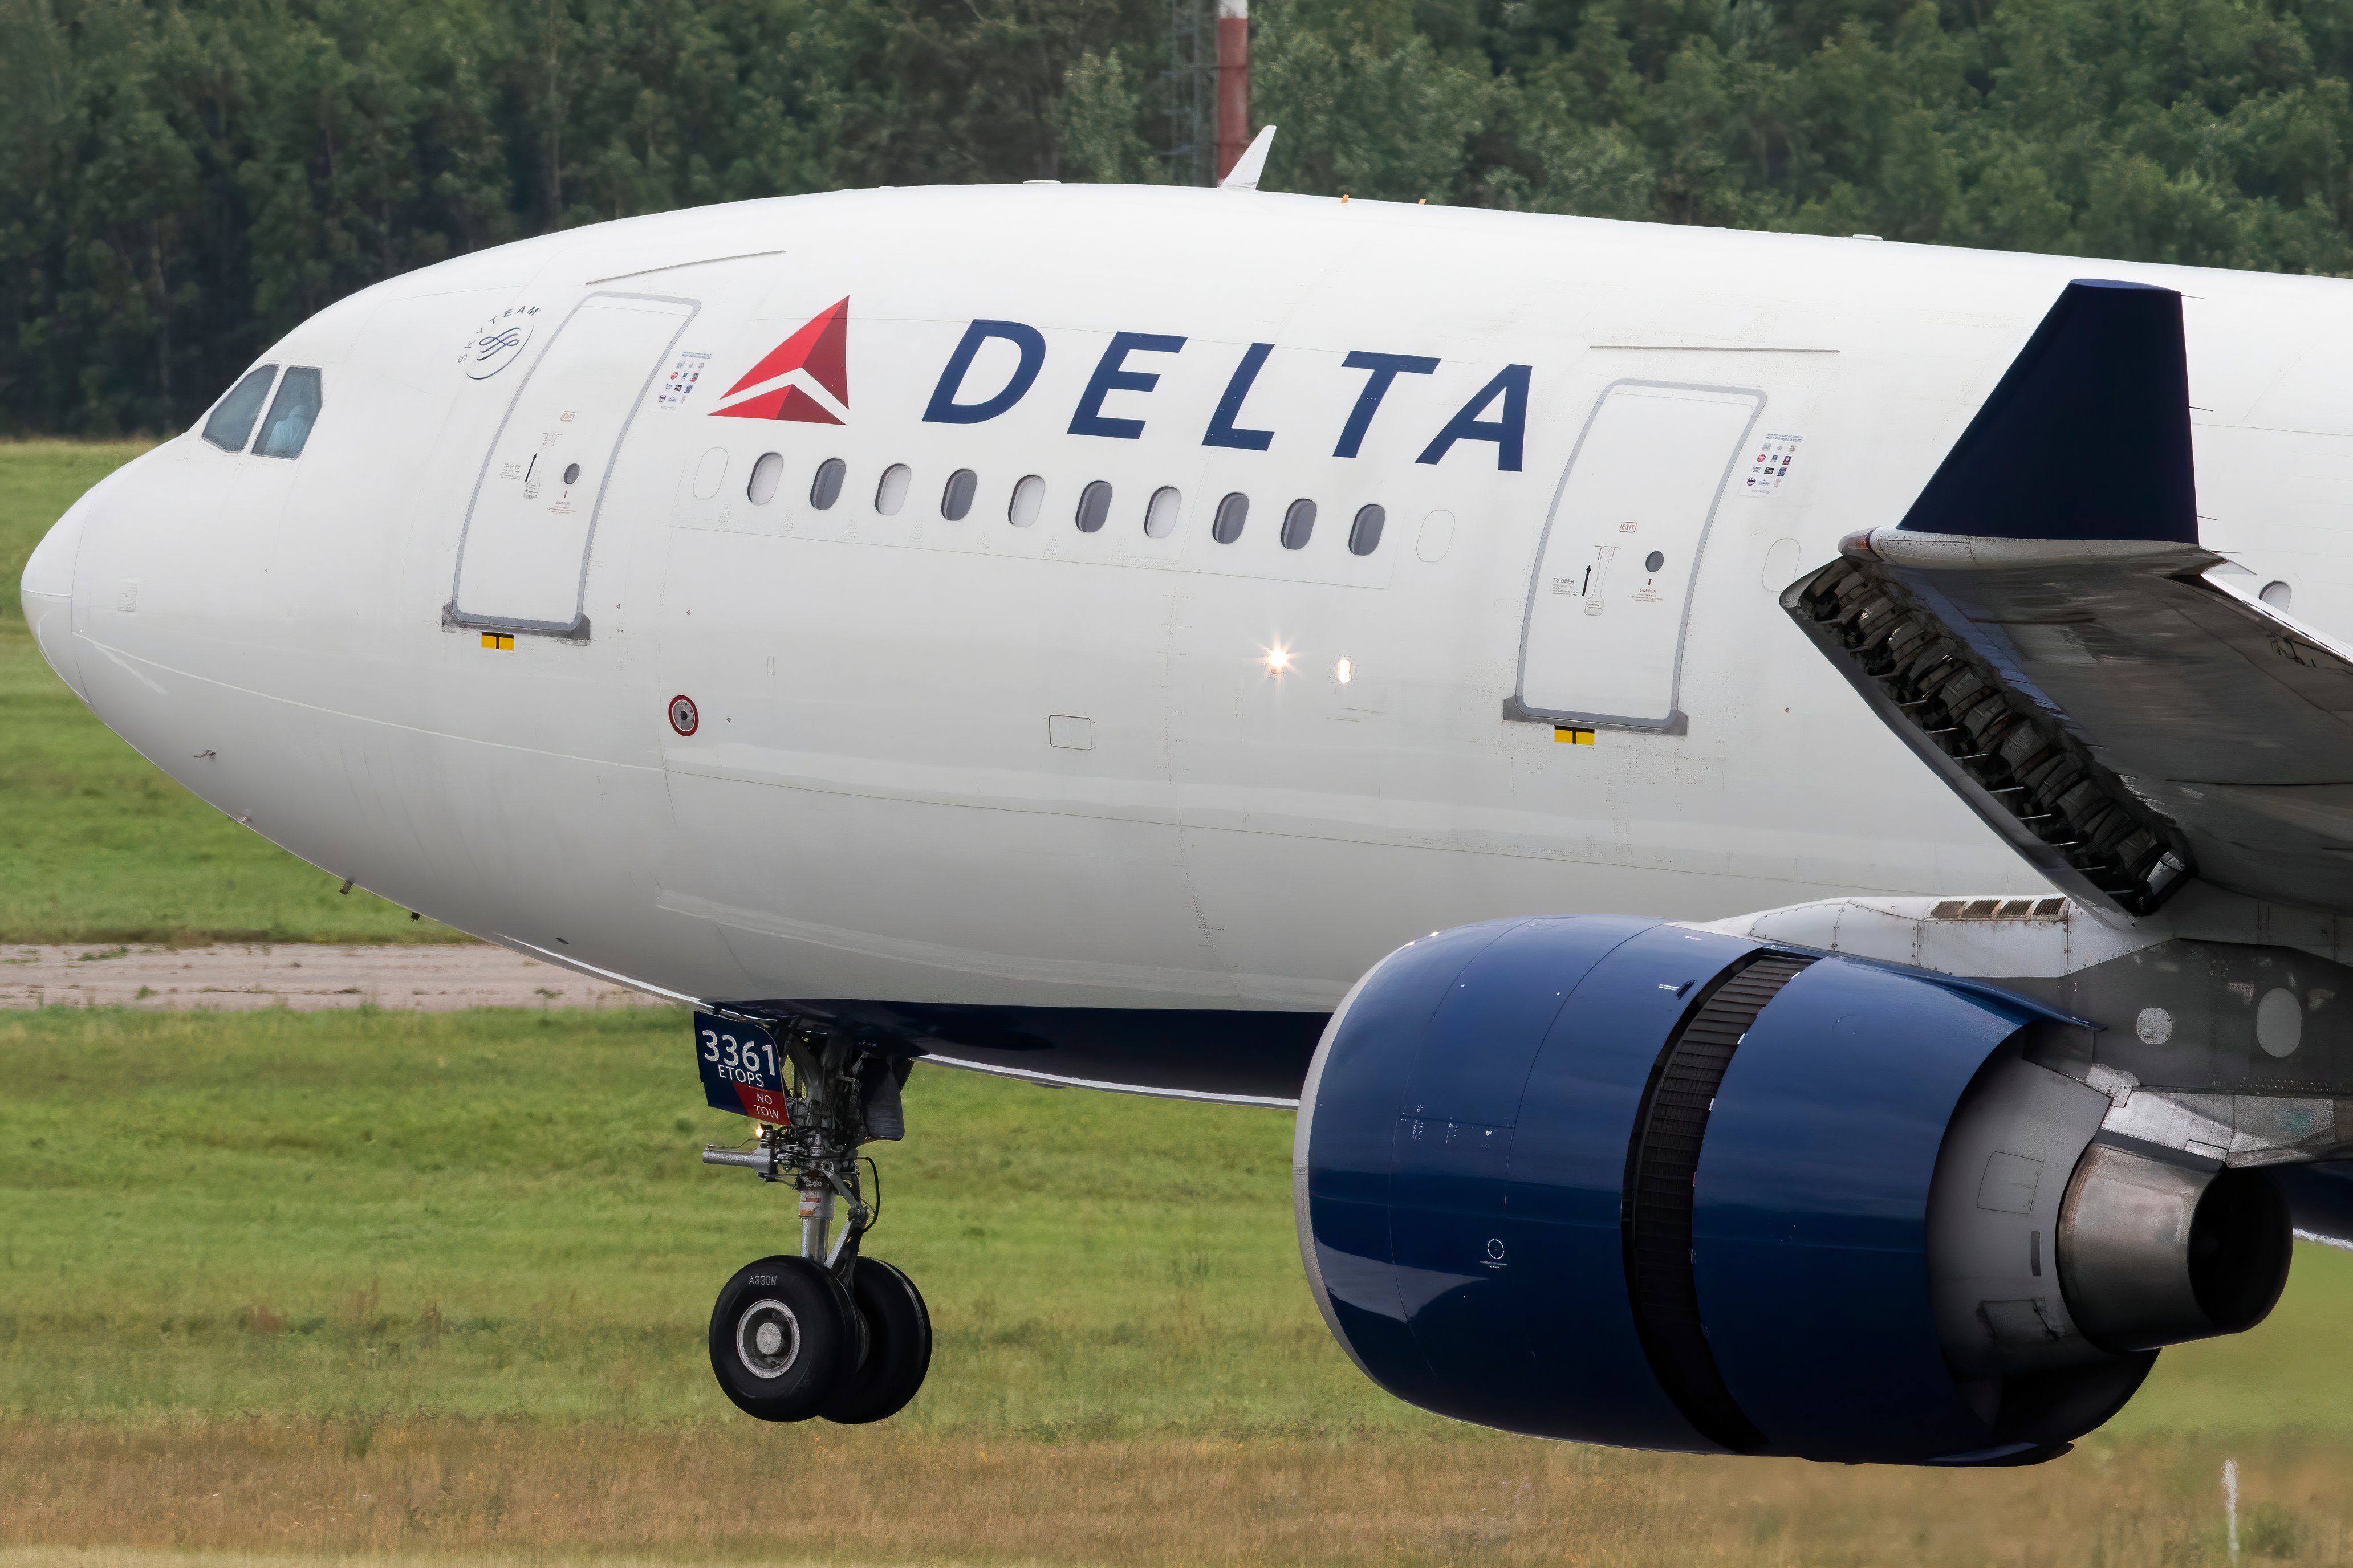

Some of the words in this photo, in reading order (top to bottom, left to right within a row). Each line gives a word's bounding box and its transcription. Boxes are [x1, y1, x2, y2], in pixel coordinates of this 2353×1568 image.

[457, 305, 541, 363] SKYTEAM
[922, 319, 1533, 472] DELTA
[702, 1029, 776, 1076] 3361
[718, 1064, 765, 1088] ETOPS
[754, 1105, 779, 1119] TOW
[757, 1093, 773, 1105] NO
